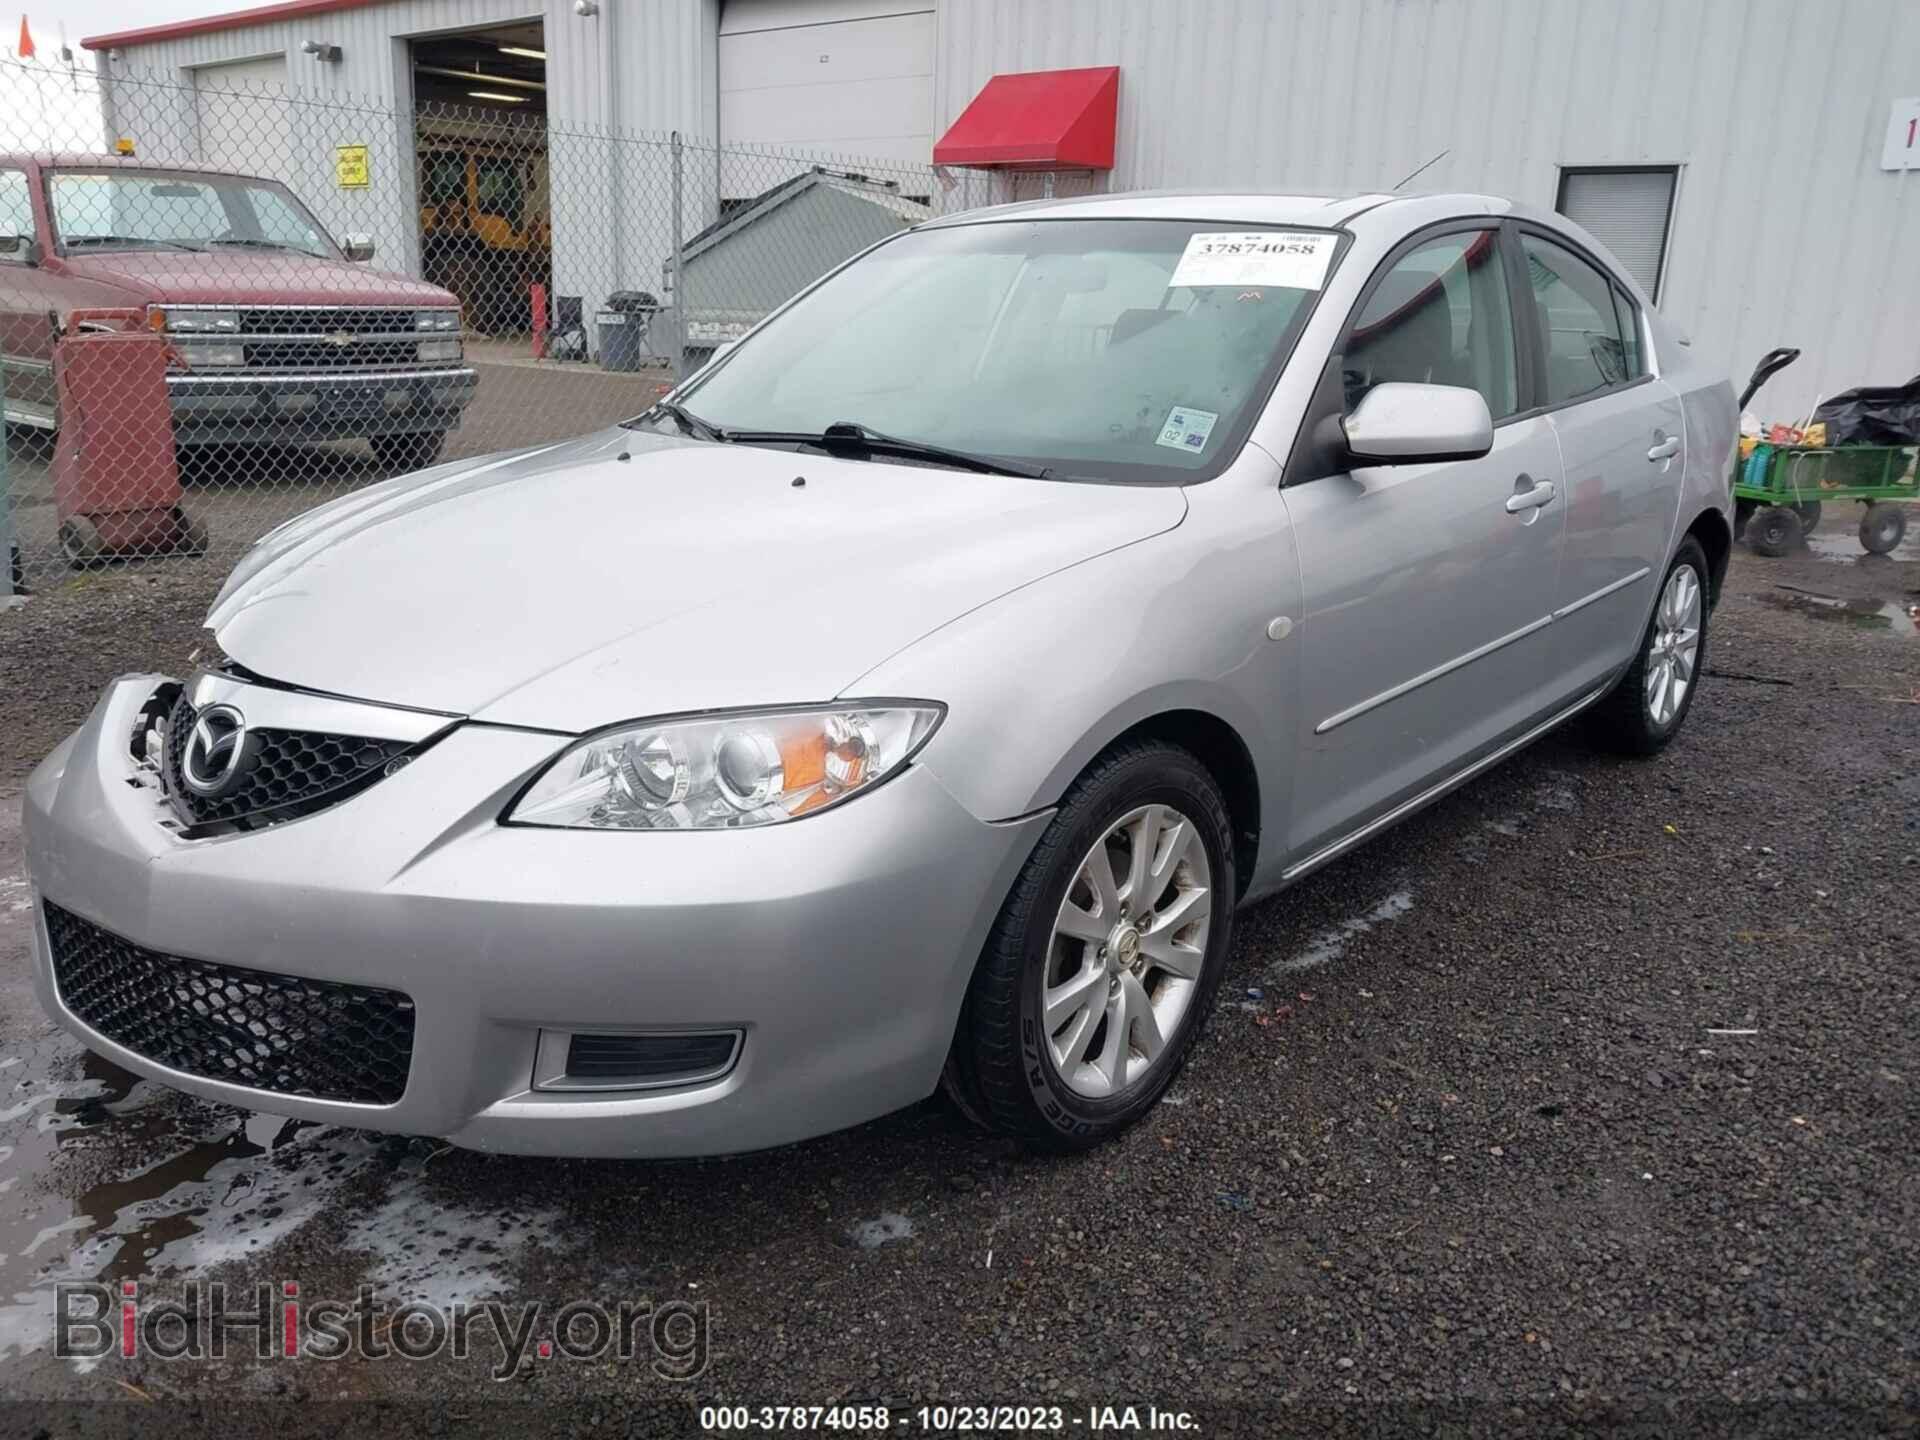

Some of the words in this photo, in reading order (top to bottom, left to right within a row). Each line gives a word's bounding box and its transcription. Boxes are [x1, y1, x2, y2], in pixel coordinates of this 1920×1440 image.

[1199, 242, 1316, 255] 37874058
[1164, 430, 1181, 441] 02
[1184, 433, 1206, 448] 23
